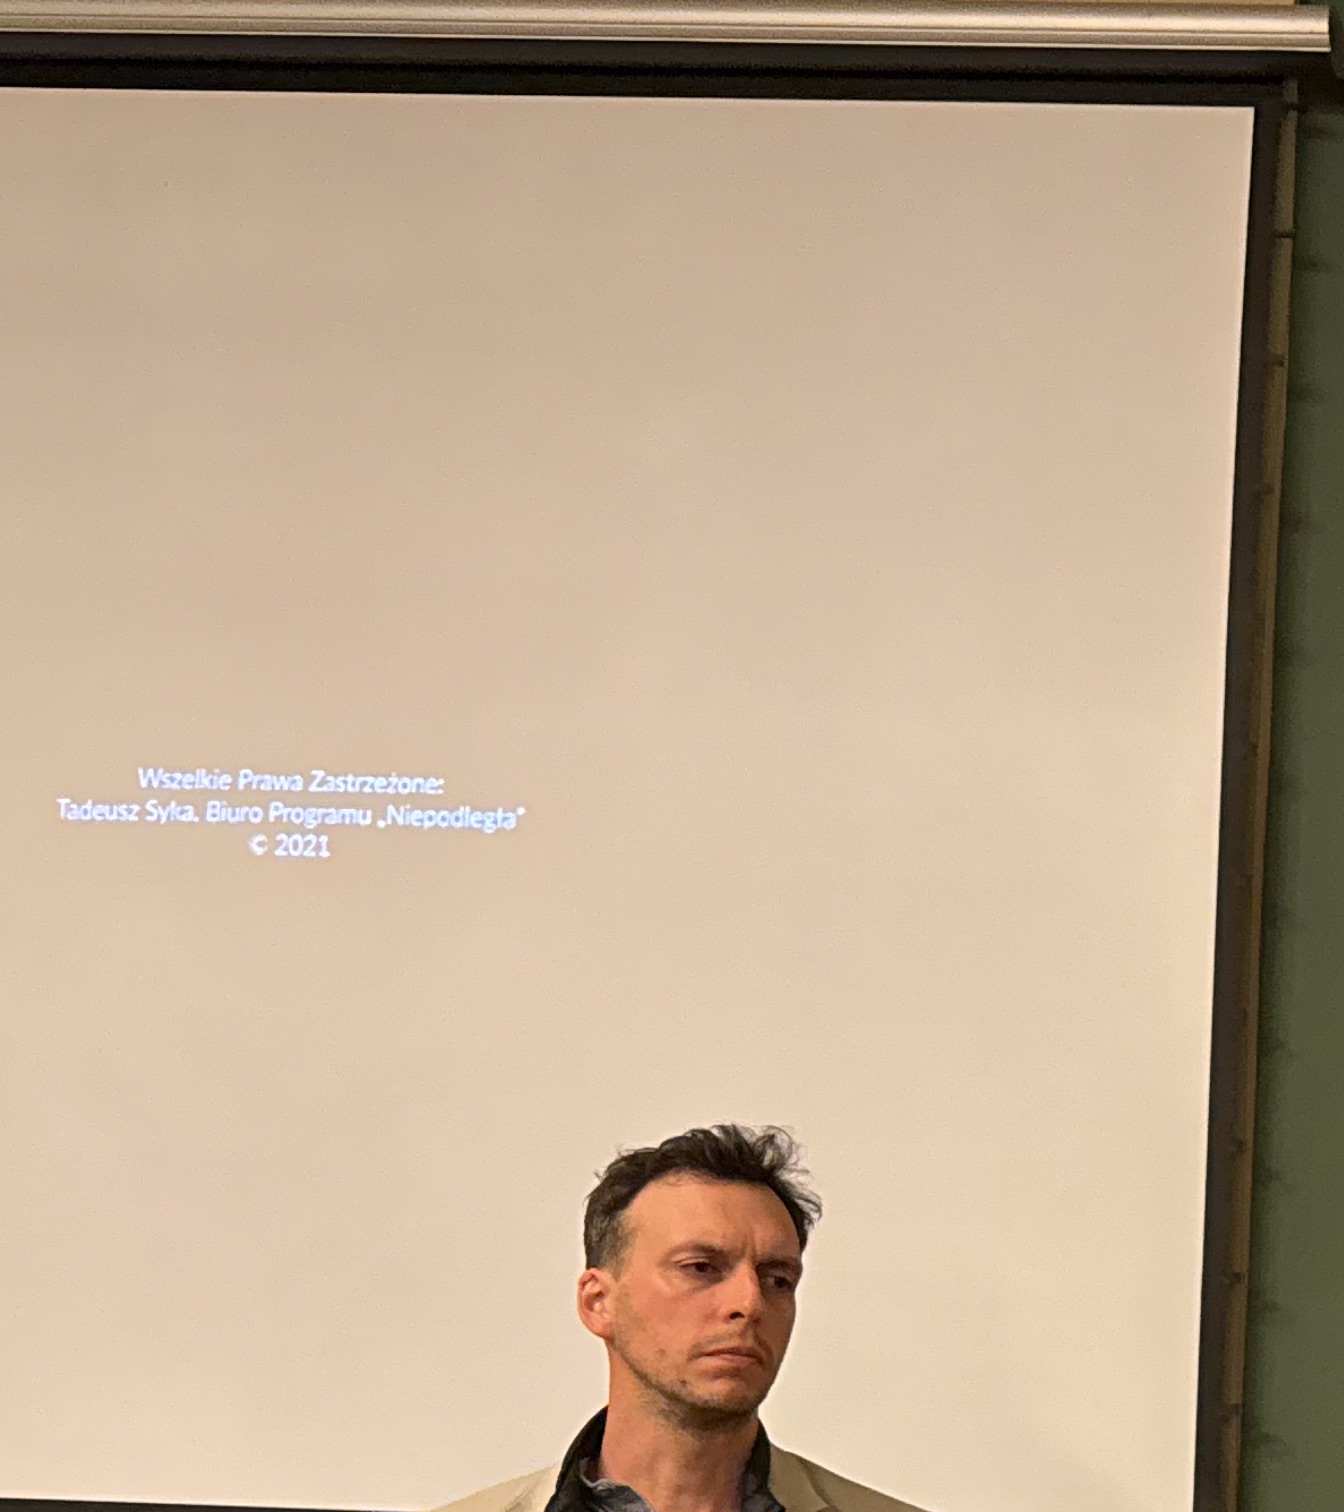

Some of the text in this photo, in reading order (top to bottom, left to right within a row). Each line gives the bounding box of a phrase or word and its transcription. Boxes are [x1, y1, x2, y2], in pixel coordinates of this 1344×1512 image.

[137, 767, 445, 794] Wszelkie Prawa Zastrzeżone:
[56, 798, 141, 821] Tadeusz
[205, 800, 264, 824] Biuro
[268, 802, 372, 829] Programu
[274, 833, 331, 858] 2021
